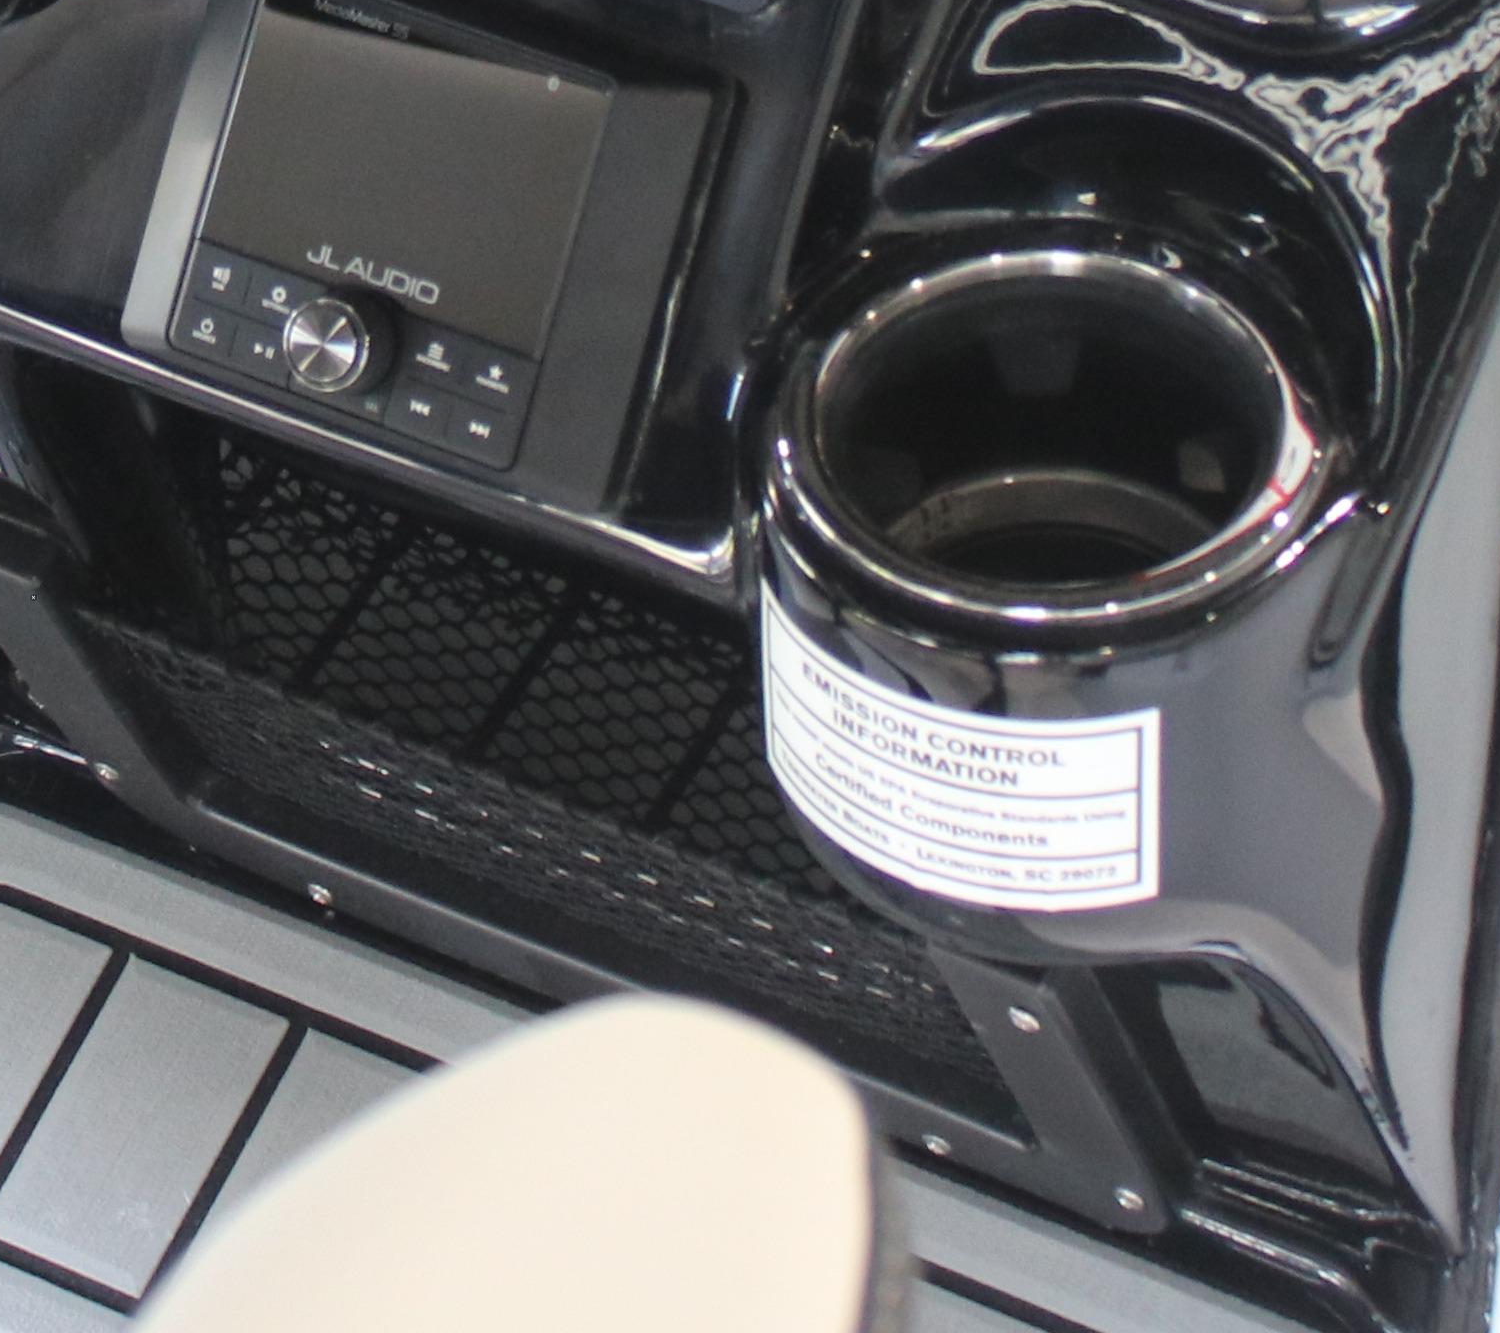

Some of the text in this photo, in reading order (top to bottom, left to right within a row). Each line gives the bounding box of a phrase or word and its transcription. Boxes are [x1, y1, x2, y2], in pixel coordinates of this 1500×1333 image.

[306, 244, 439, 305] JL AUDIO
[802, 661, 918, 741] EMISSION
[927, 732, 1066, 767] CONTROL
[833, 708, 1018, 787] INFORMATION
[815, 752, 1049, 848] Certified Components
